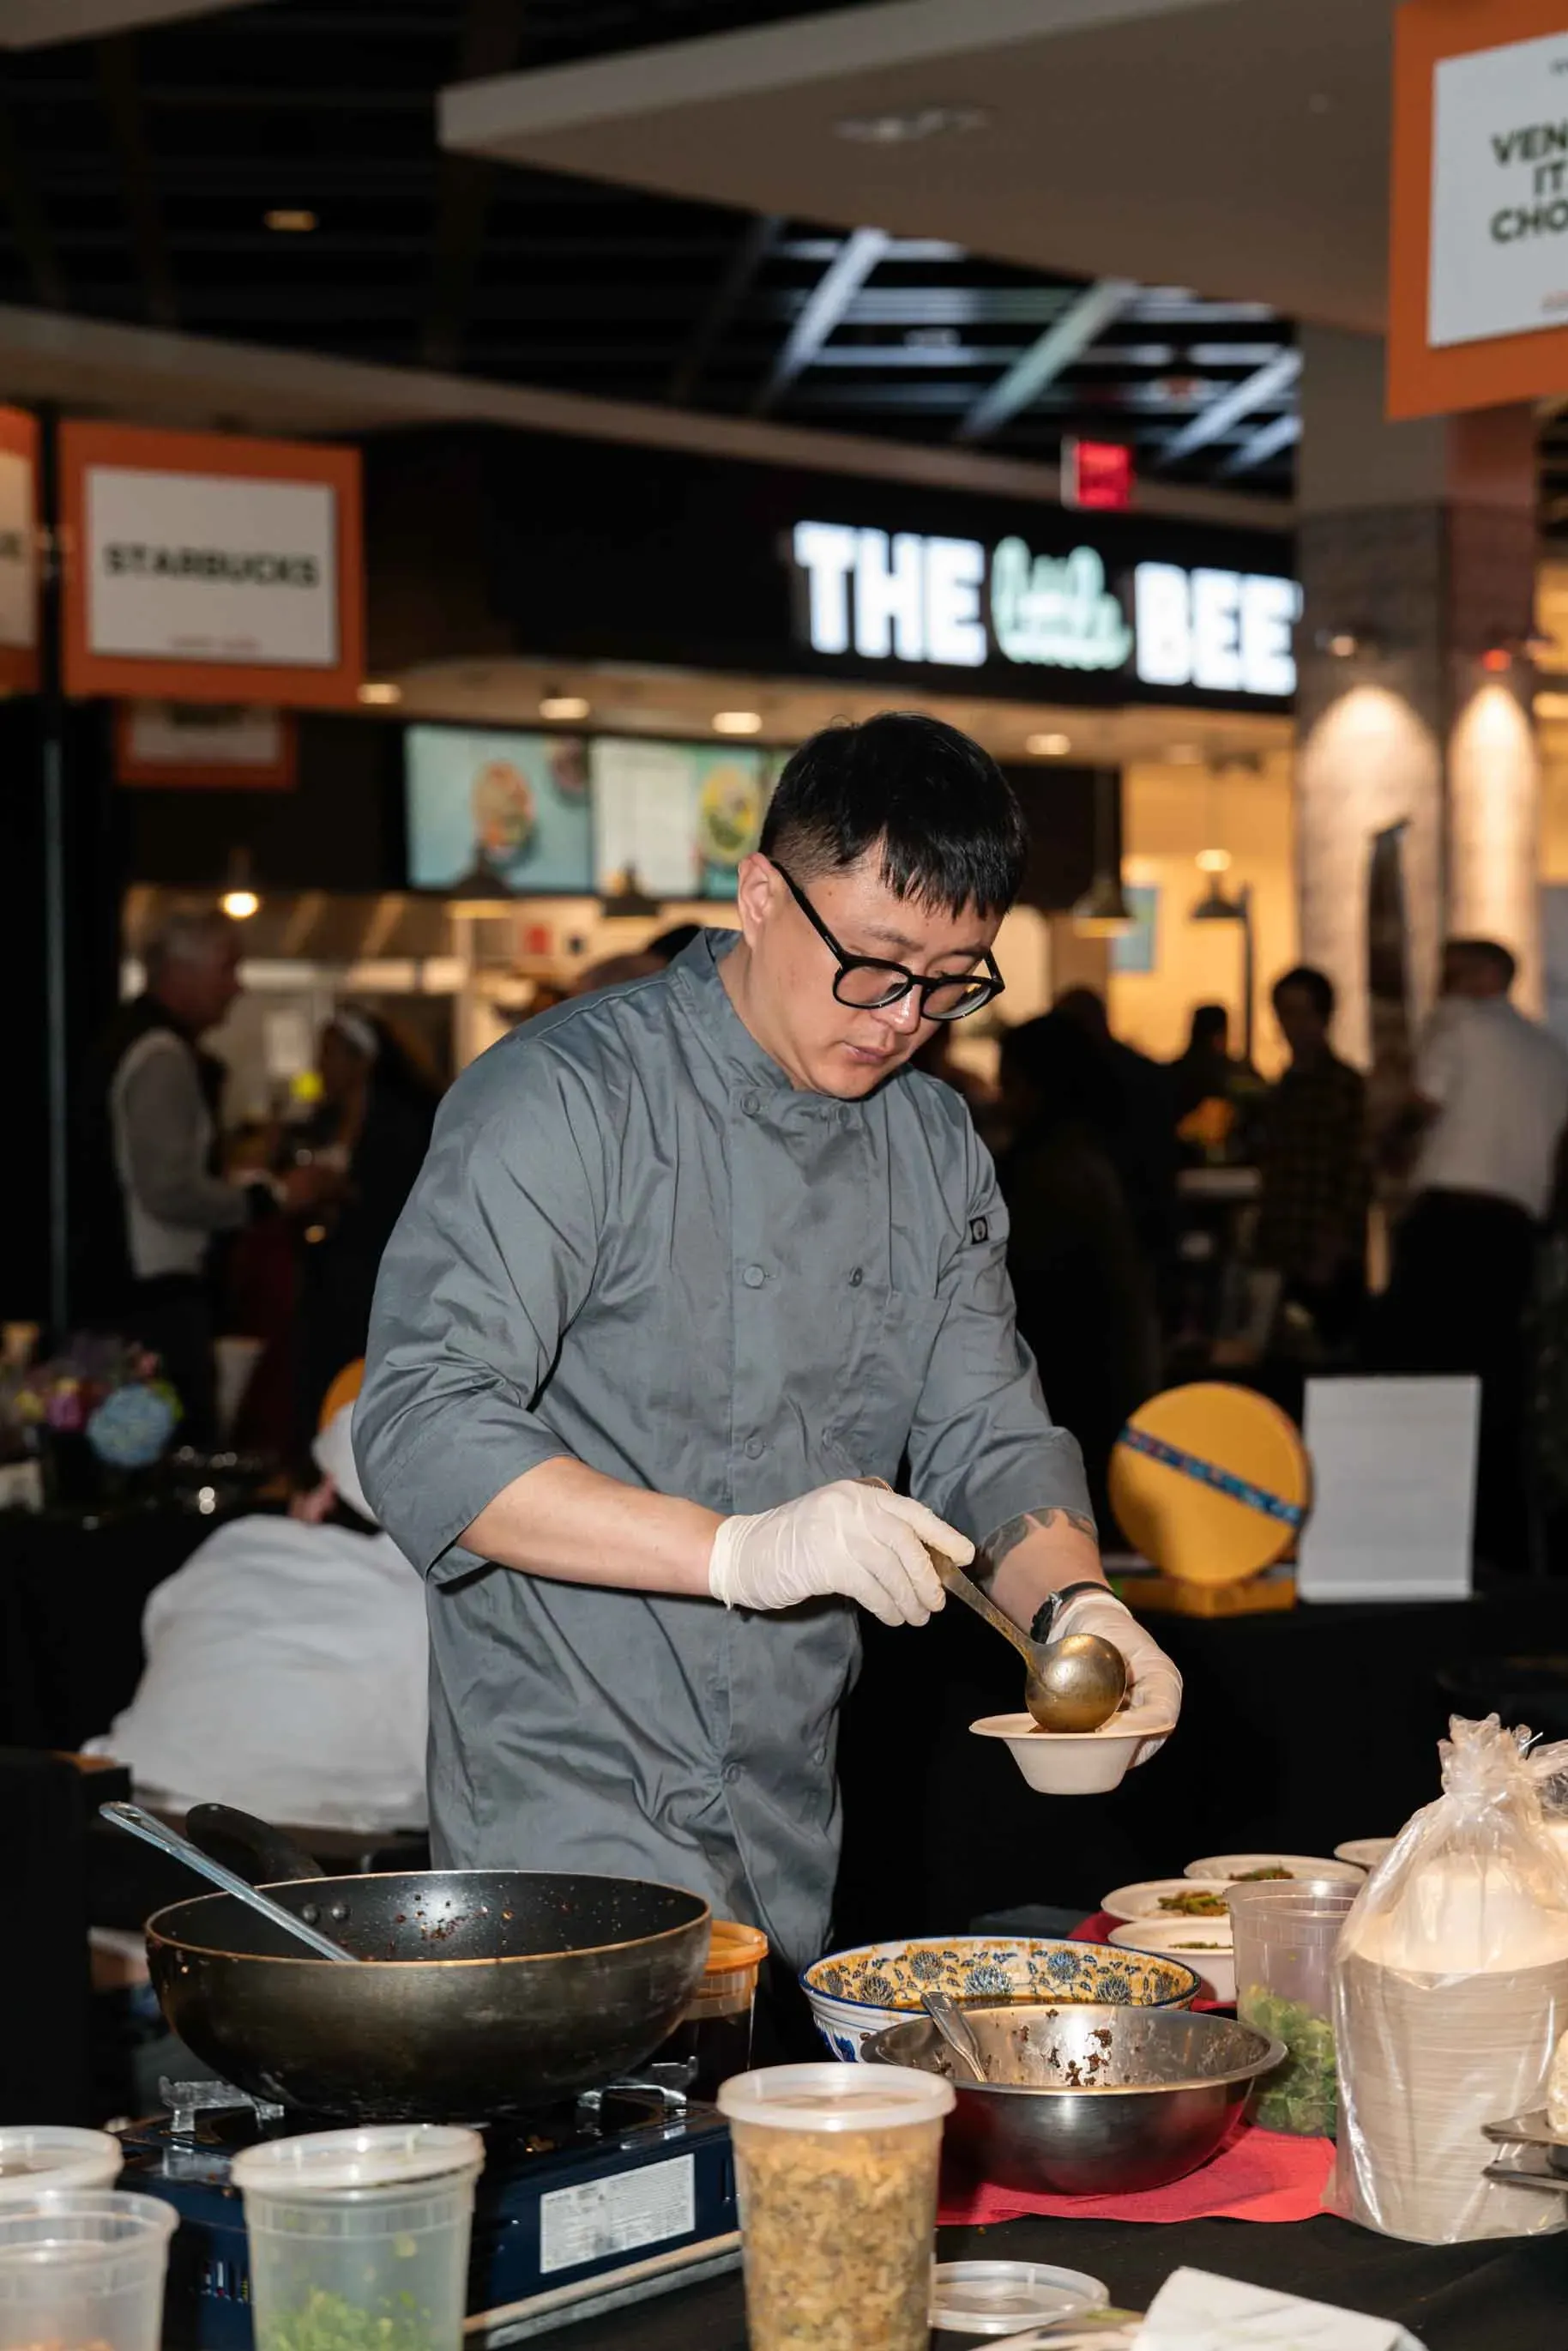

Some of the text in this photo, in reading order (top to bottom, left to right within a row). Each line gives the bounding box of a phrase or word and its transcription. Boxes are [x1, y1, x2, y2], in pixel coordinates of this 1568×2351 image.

[104, 544, 318, 589] STARBUCKS
[793, 520, 986, 668] THE
[1134, 562, 1303, 697] BEE
